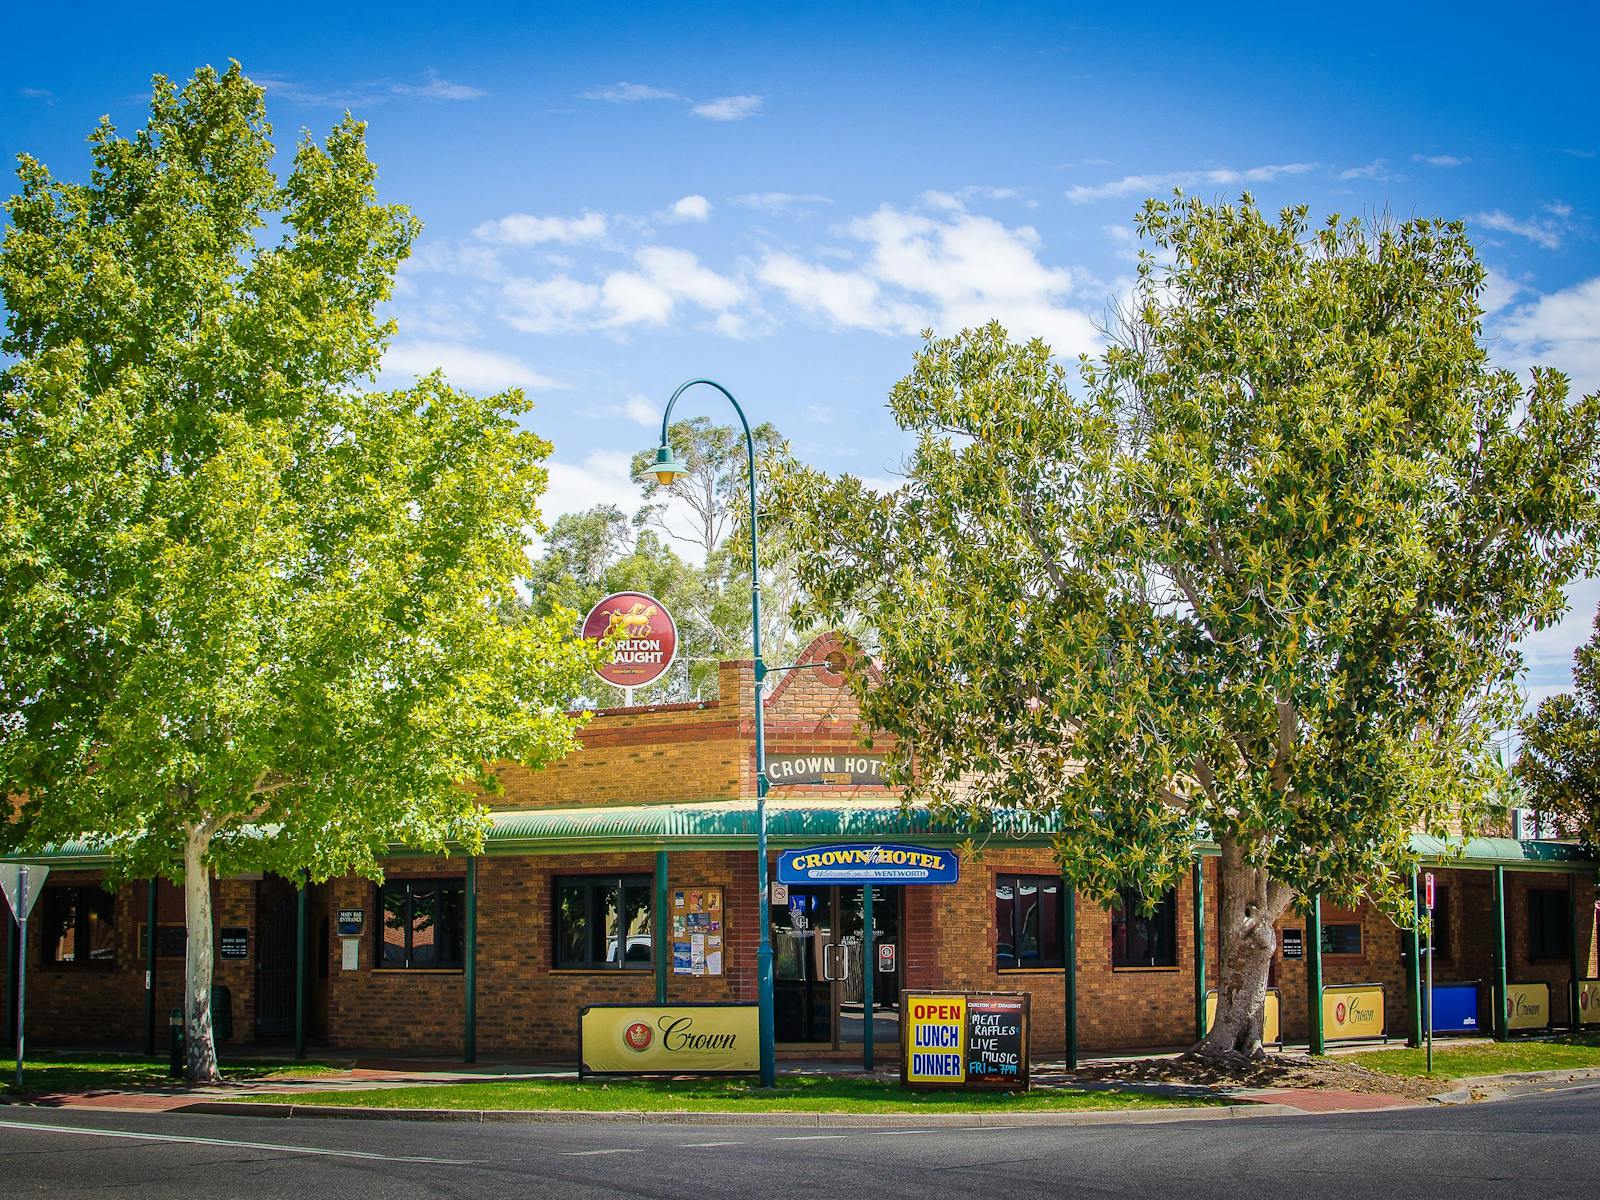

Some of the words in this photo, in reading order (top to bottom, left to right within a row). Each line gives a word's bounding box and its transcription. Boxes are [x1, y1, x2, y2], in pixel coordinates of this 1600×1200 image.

[769, 757, 835, 779] CROWN
[845, 757, 885, 776] HOT
[792, 850, 869, 871] CROWN
[879, 849, 945, 871] HOTEL
[914, 1004, 961, 1020] OPEN
[1347, 995, 1374, 1024] Crown
[972, 1014, 1001, 1025] MEAT
[657, 1015, 737, 1051] Crown
[915, 1024, 960, 1048] LUNCH
[974, 1025, 1016, 1037] RAFFLES
[970, 1038, 998, 1051] LIVE
[913, 1053, 962, 1077] DINNER
[981, 1051, 1018, 1065] MUSIC
[969, 1061, 986, 1075] FRI
[1000, 1063, 1018, 1075] 7PM
